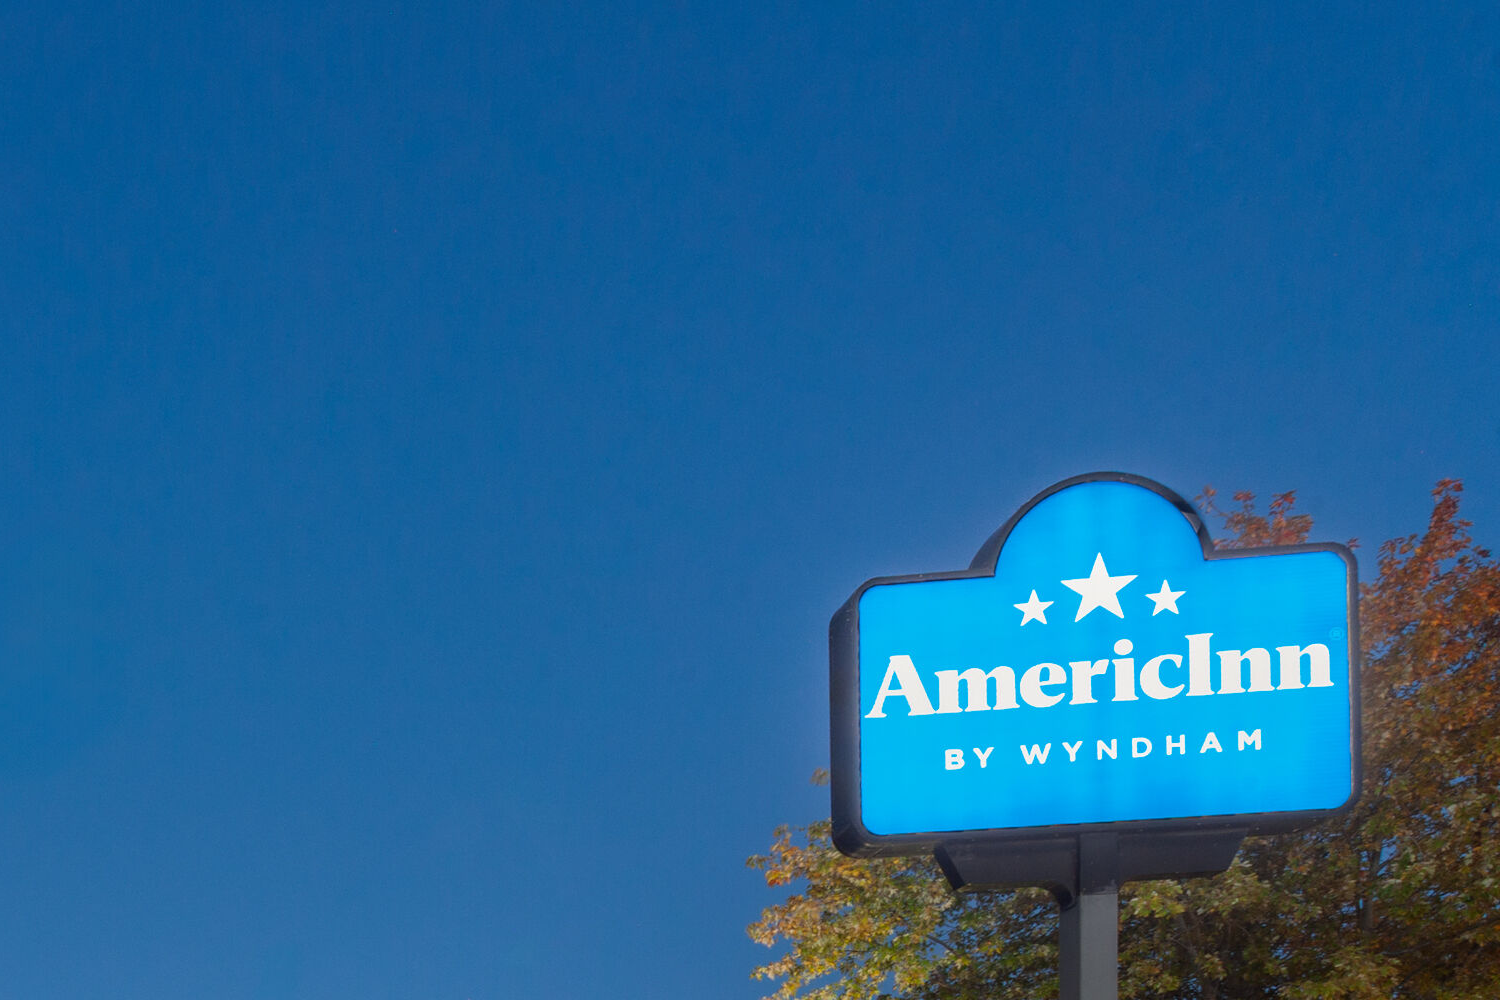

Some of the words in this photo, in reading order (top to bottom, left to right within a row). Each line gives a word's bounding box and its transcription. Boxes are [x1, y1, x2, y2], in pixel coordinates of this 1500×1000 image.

[864, 632, 1335, 719] AmericInn
[944, 746, 995, 771] BY
[1019, 728, 1263, 765] WYNDHAM
